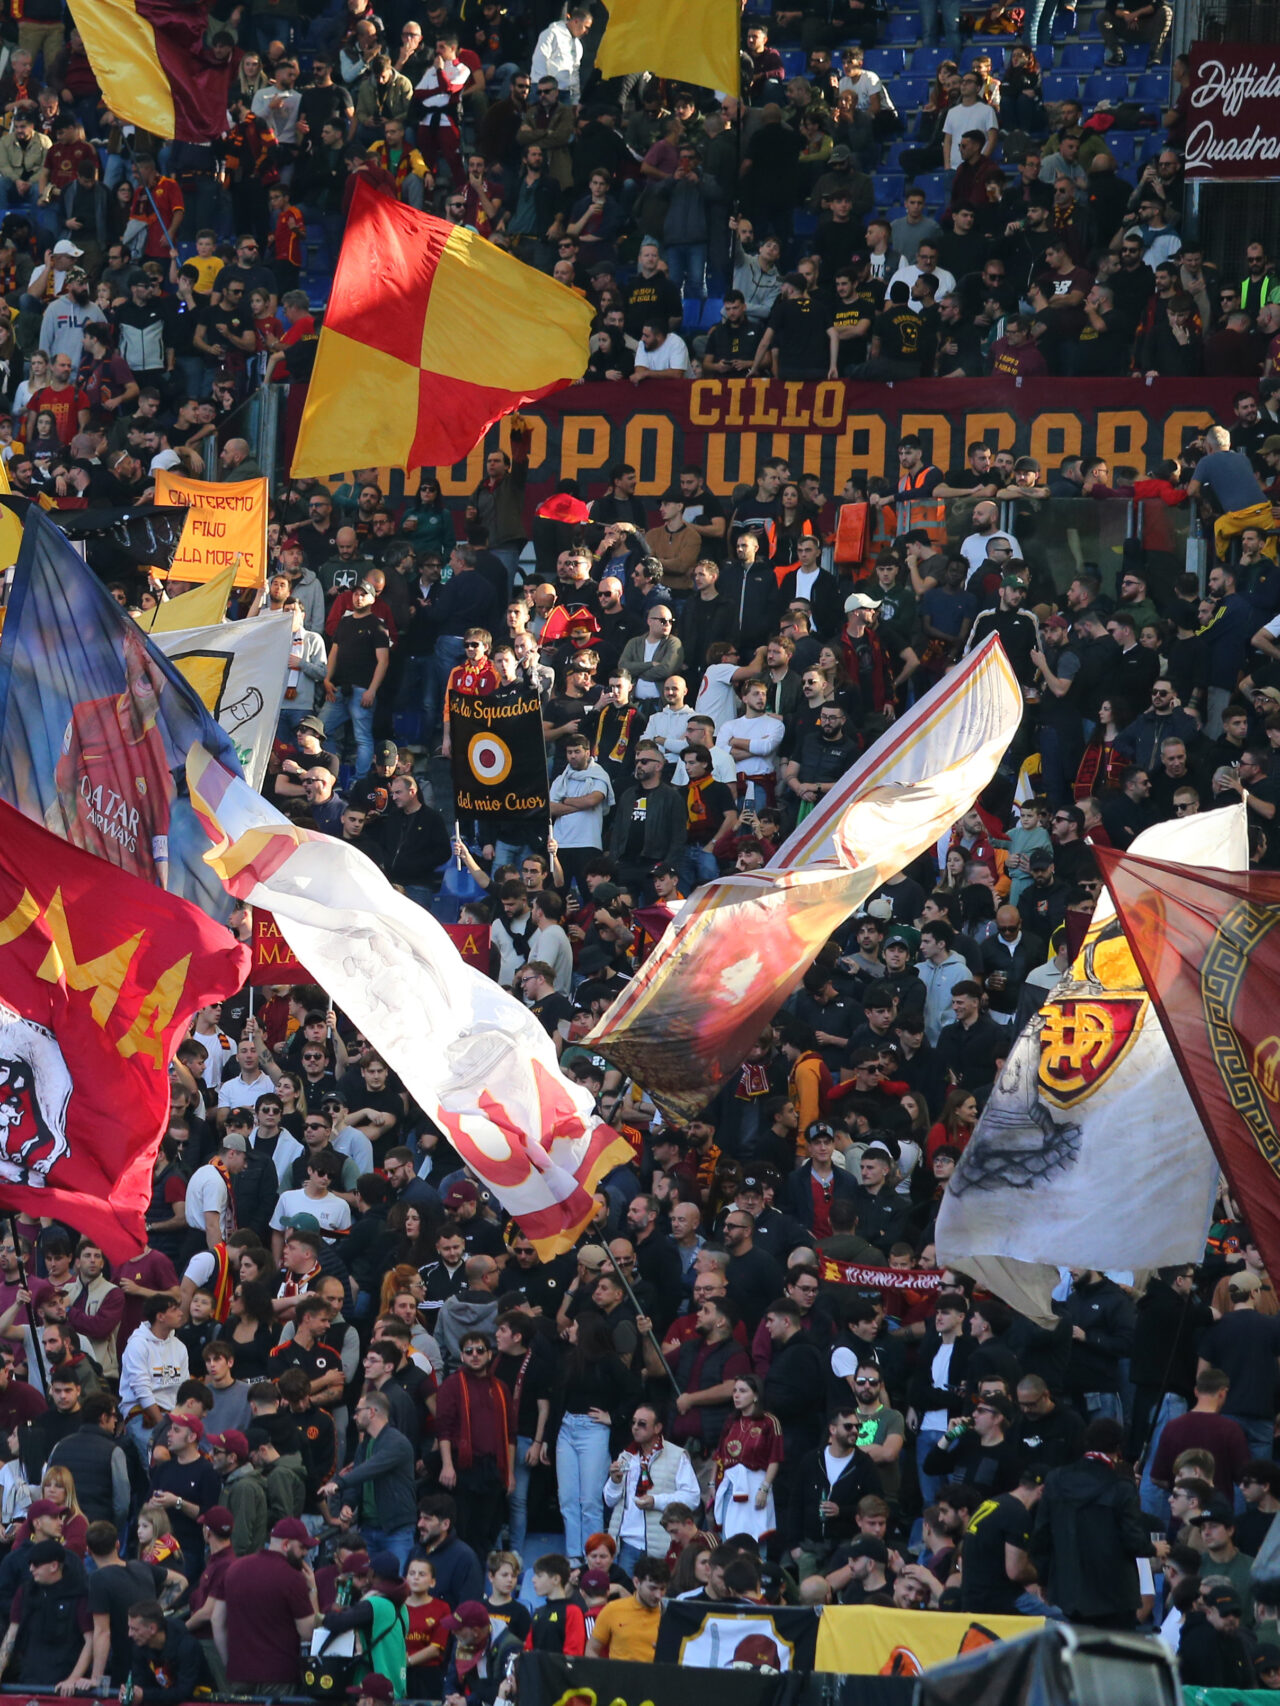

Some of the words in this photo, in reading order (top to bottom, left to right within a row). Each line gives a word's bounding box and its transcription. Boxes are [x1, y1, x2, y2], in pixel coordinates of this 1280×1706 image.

[690, 379, 846, 428] CILLO
[192, 520, 227, 538] FINO
[173, 547, 202, 564] LLA
[473, 697, 541, 727] Squadra
[81, 775, 140, 837] QATAR
[457, 791, 473, 809] del
[475, 796, 501, 811] mio
[86, 808, 137, 853] AIRWAYS
